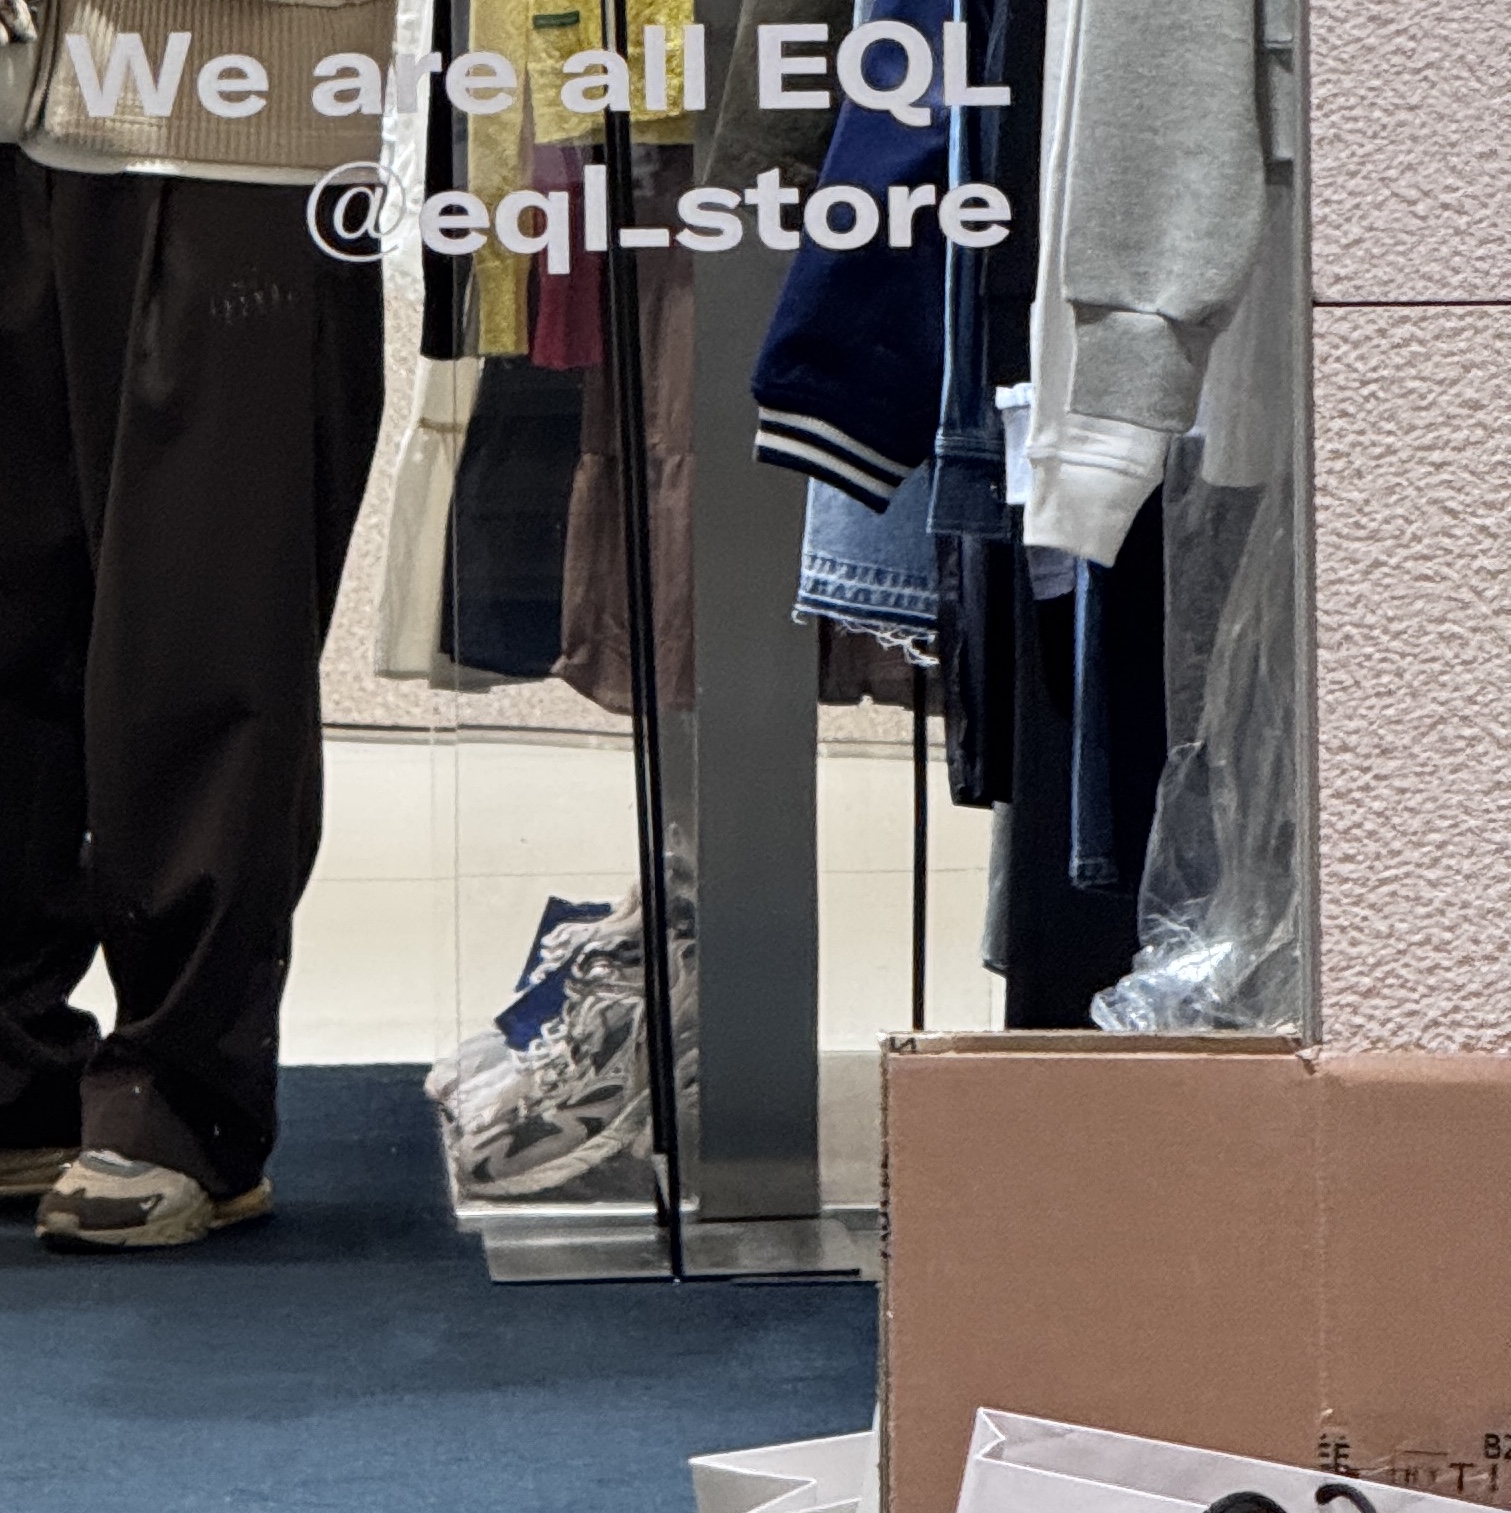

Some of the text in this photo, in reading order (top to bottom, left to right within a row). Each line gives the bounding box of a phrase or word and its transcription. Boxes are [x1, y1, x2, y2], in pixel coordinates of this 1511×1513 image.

[64, 20, 1011, 127] We are all EQL
[306, 161, 1012, 275] @eql_store
